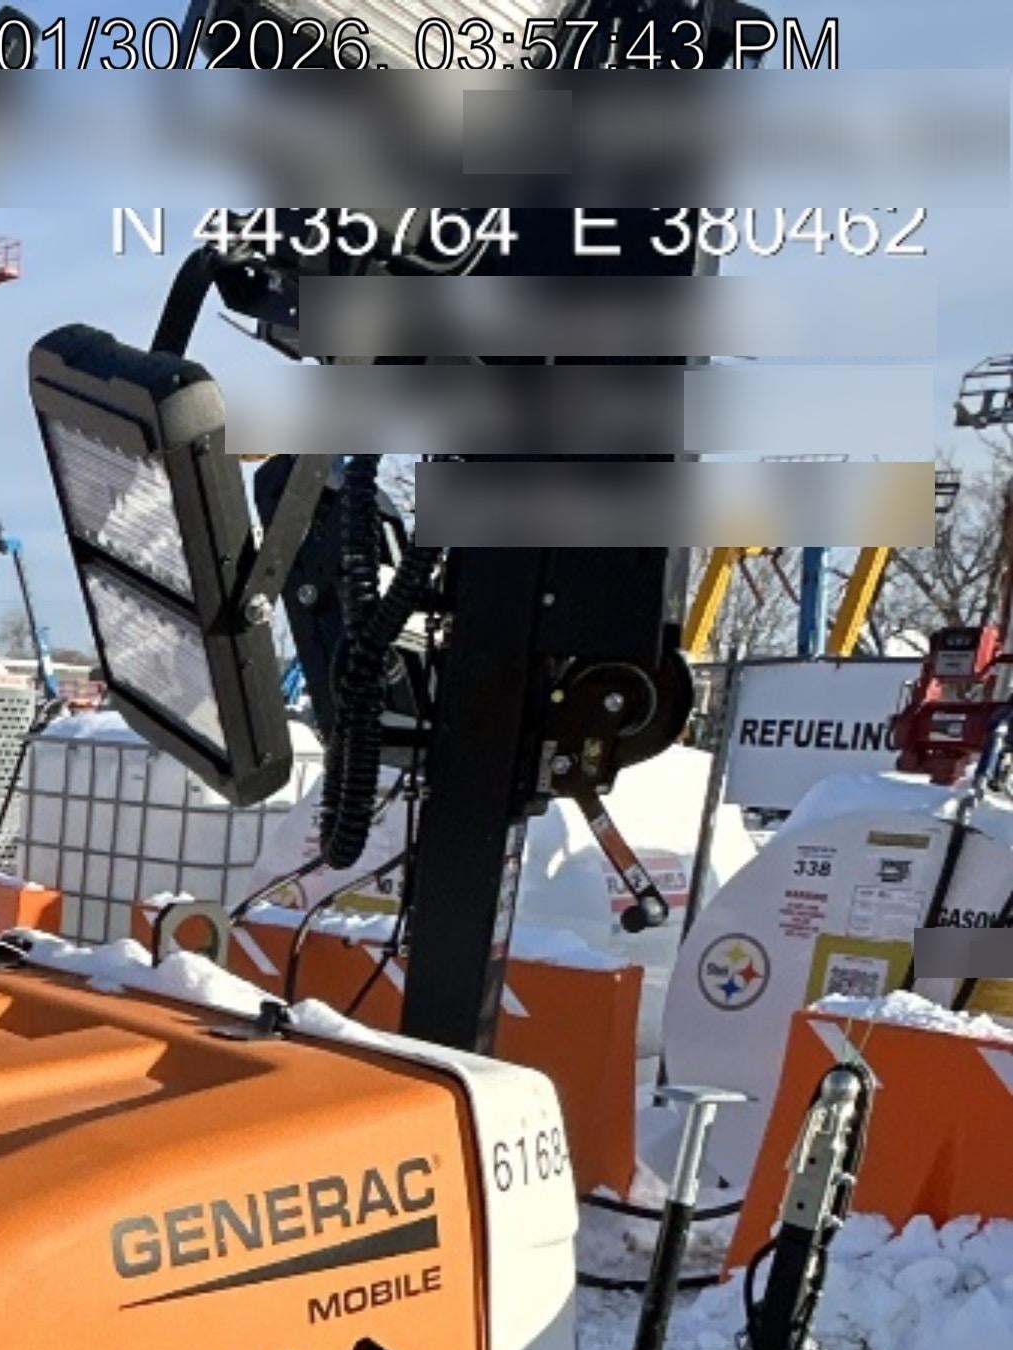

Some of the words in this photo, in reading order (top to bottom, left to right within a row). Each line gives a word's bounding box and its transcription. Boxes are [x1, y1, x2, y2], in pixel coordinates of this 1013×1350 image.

[492, 1126, 568, 1193] 6168
[110, 1155, 437, 1279] GENERAC
[307, 1265, 443, 1325] MOBILE
